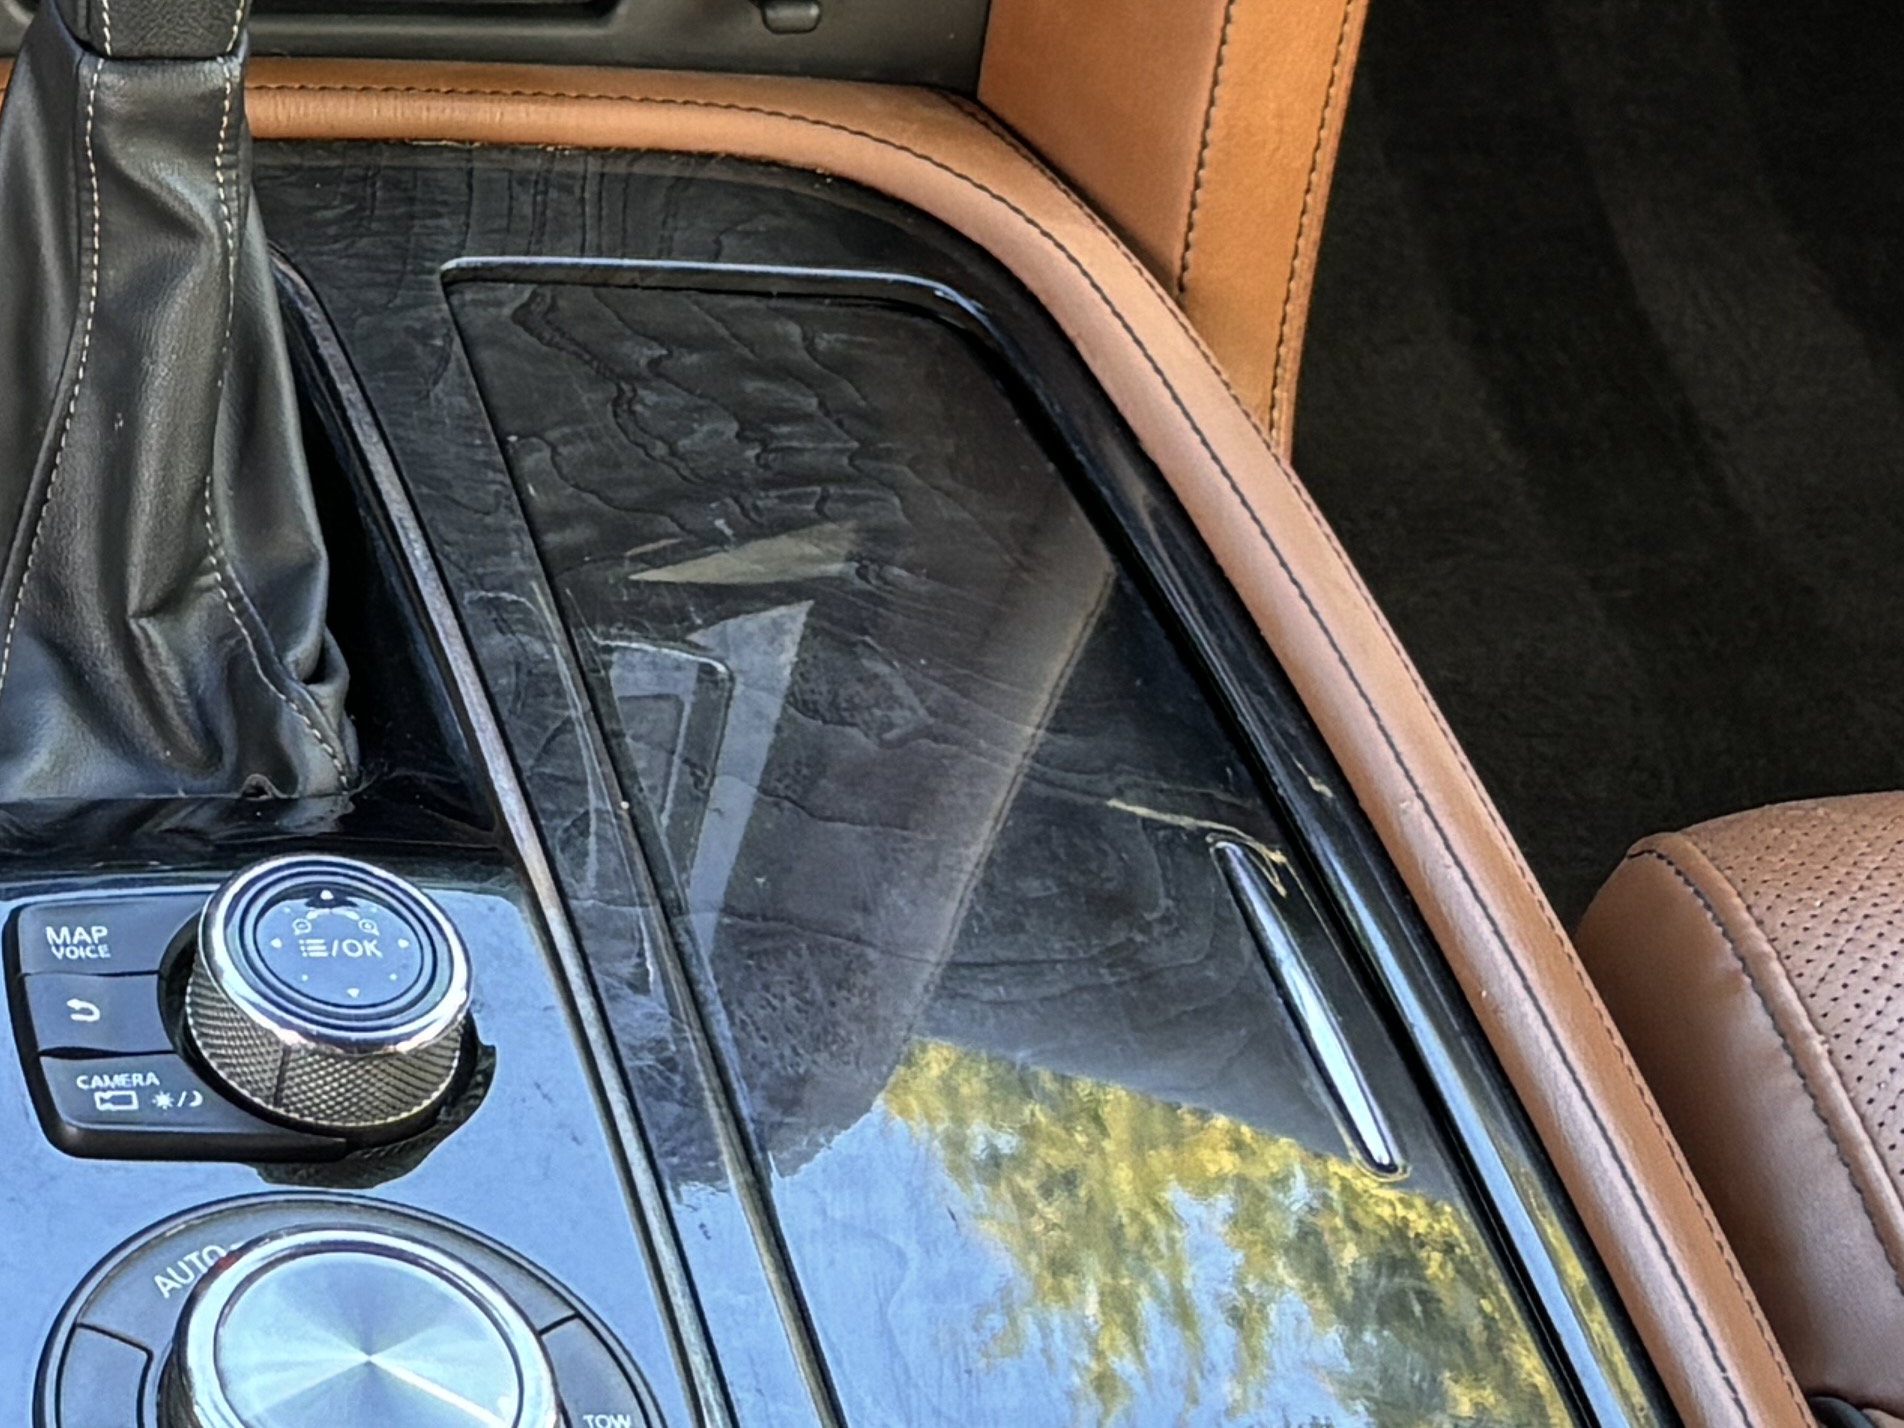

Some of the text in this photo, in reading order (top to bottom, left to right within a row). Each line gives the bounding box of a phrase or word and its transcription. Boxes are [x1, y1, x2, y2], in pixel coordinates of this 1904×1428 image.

[45, 925, 109, 946] MAP
[50, 943, 112, 960] VOICE
[75, 1072, 161, 1091] CAMERA
[153, 1244, 228, 1300] AUTO
